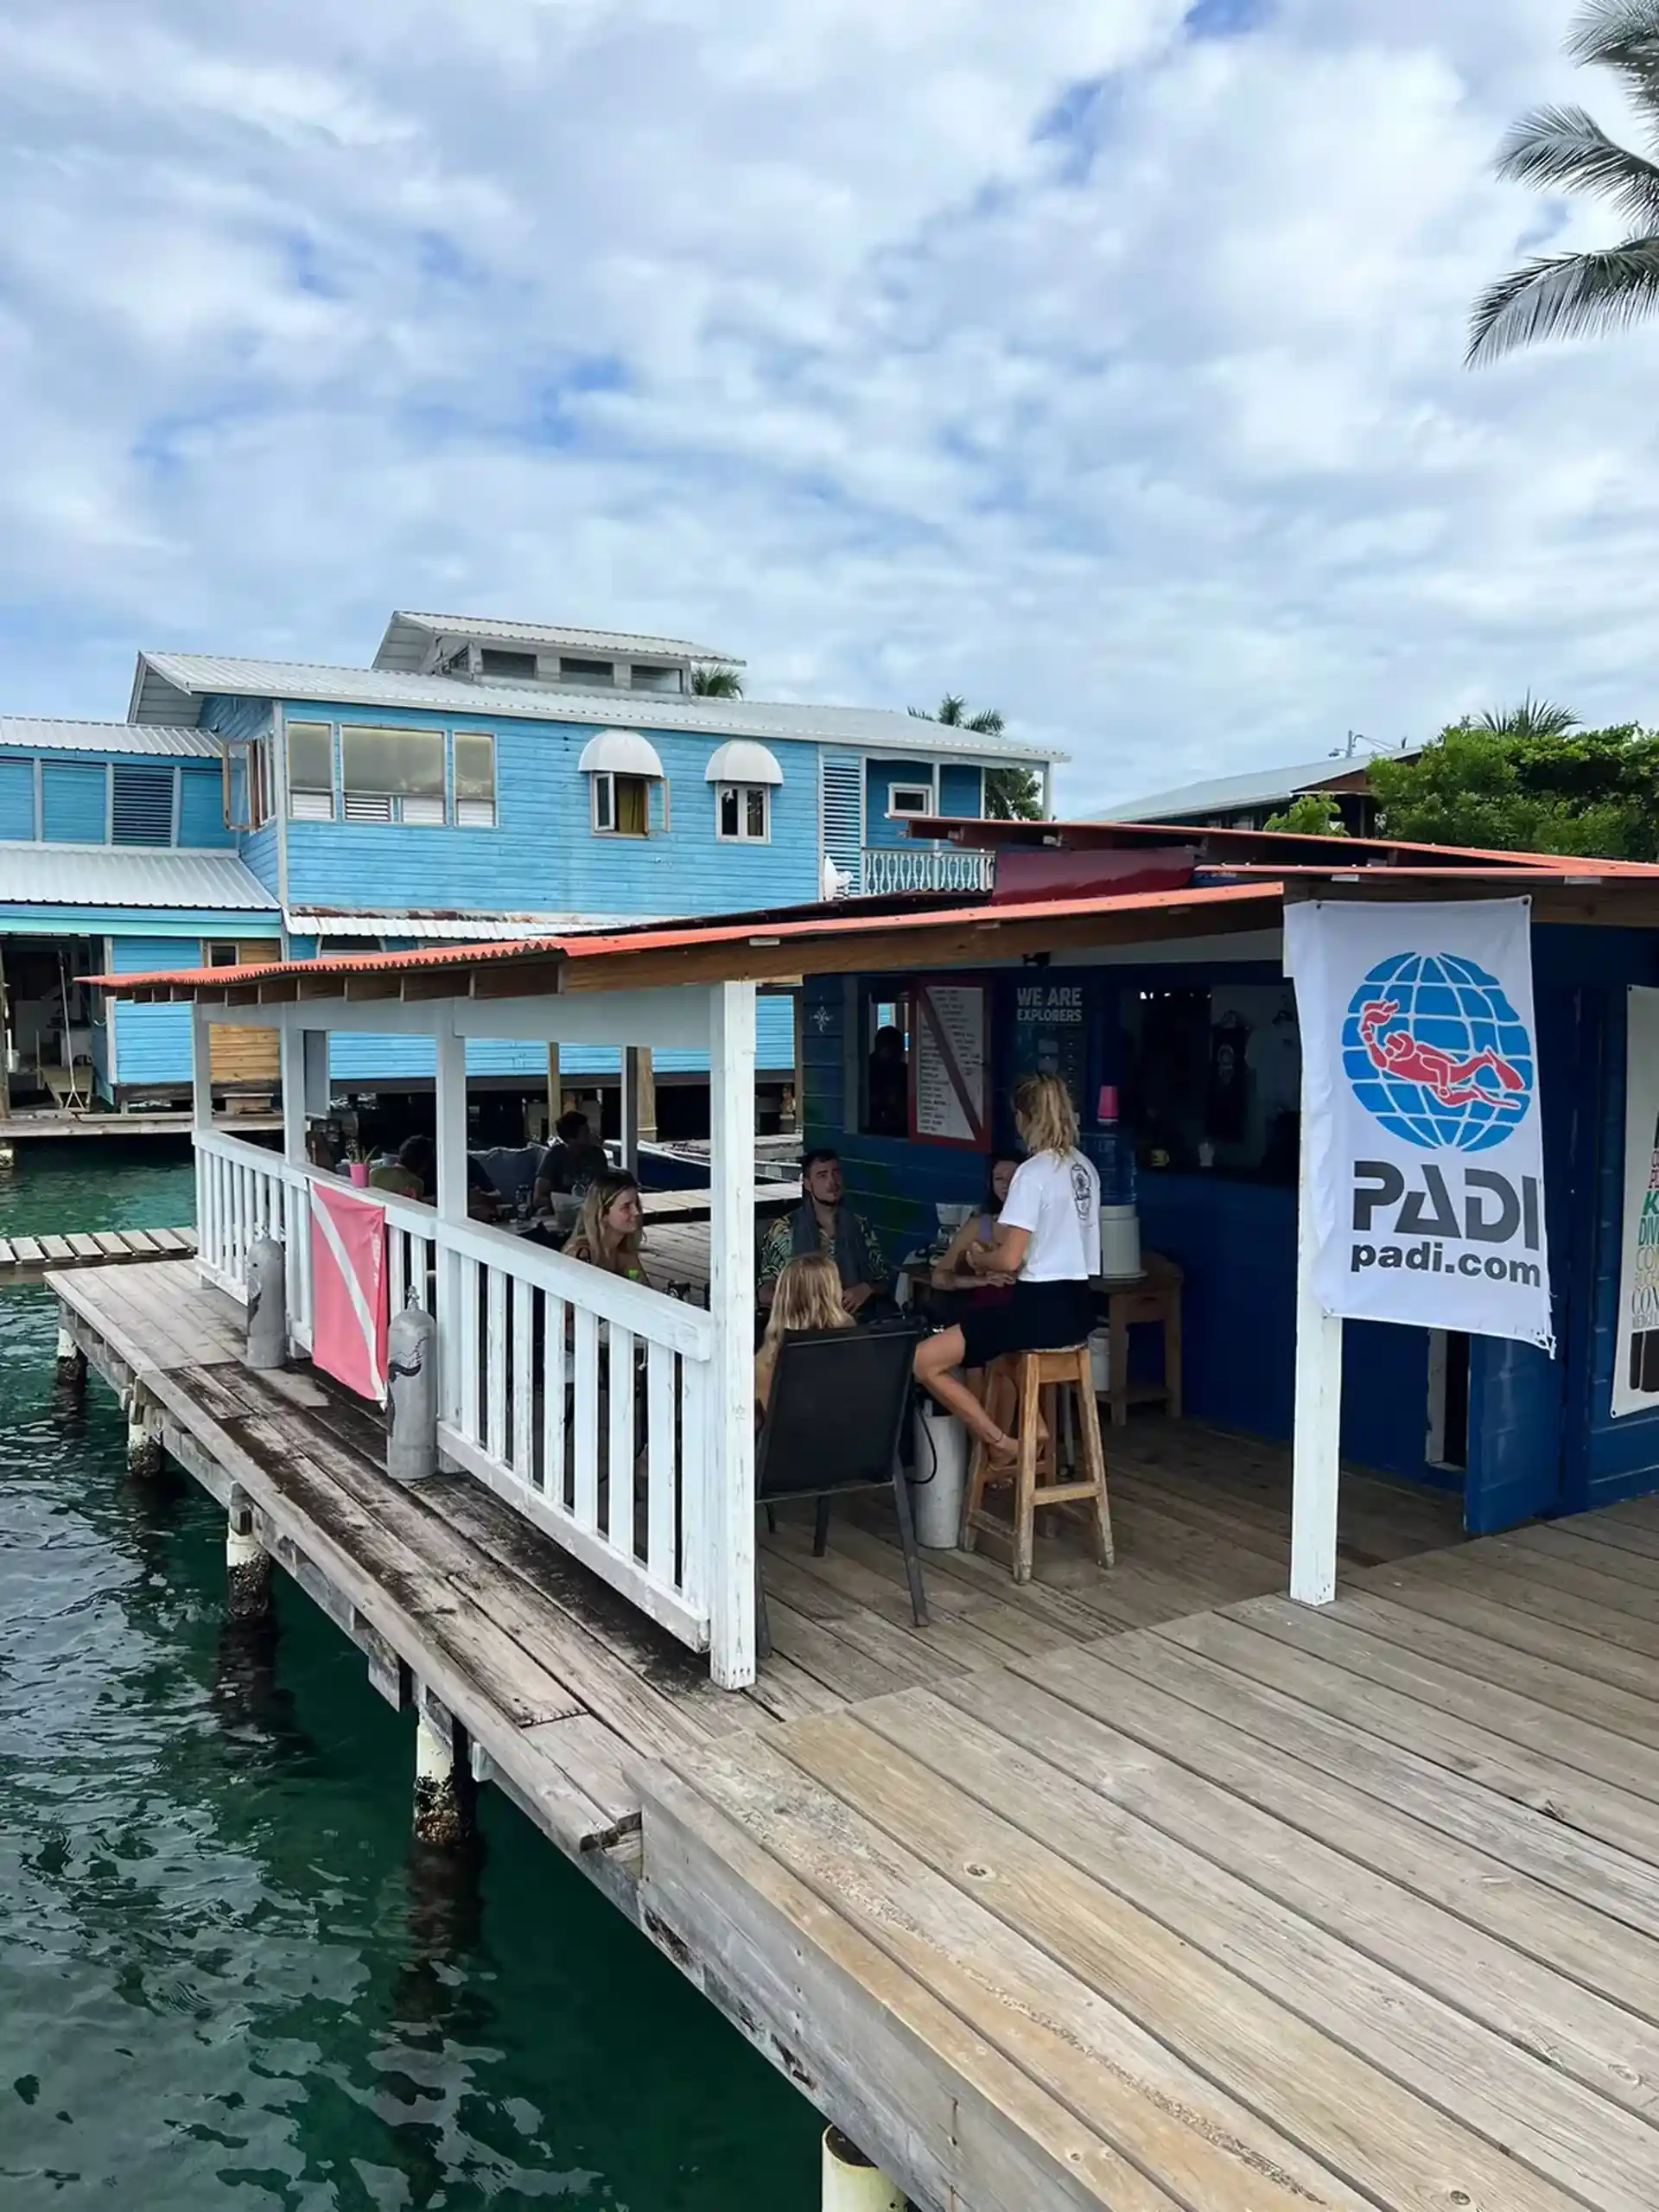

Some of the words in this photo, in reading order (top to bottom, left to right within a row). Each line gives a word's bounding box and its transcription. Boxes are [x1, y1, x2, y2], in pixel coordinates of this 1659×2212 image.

[1017, 987, 1043, 1007] WE
[1046, 987, 1083, 1007] ARE
[1016, 1008, 1083, 1022] EXPLORERS
[1352, 1160, 1540, 1251] PADI
[1351, 1242, 1541, 1287] padi.com
